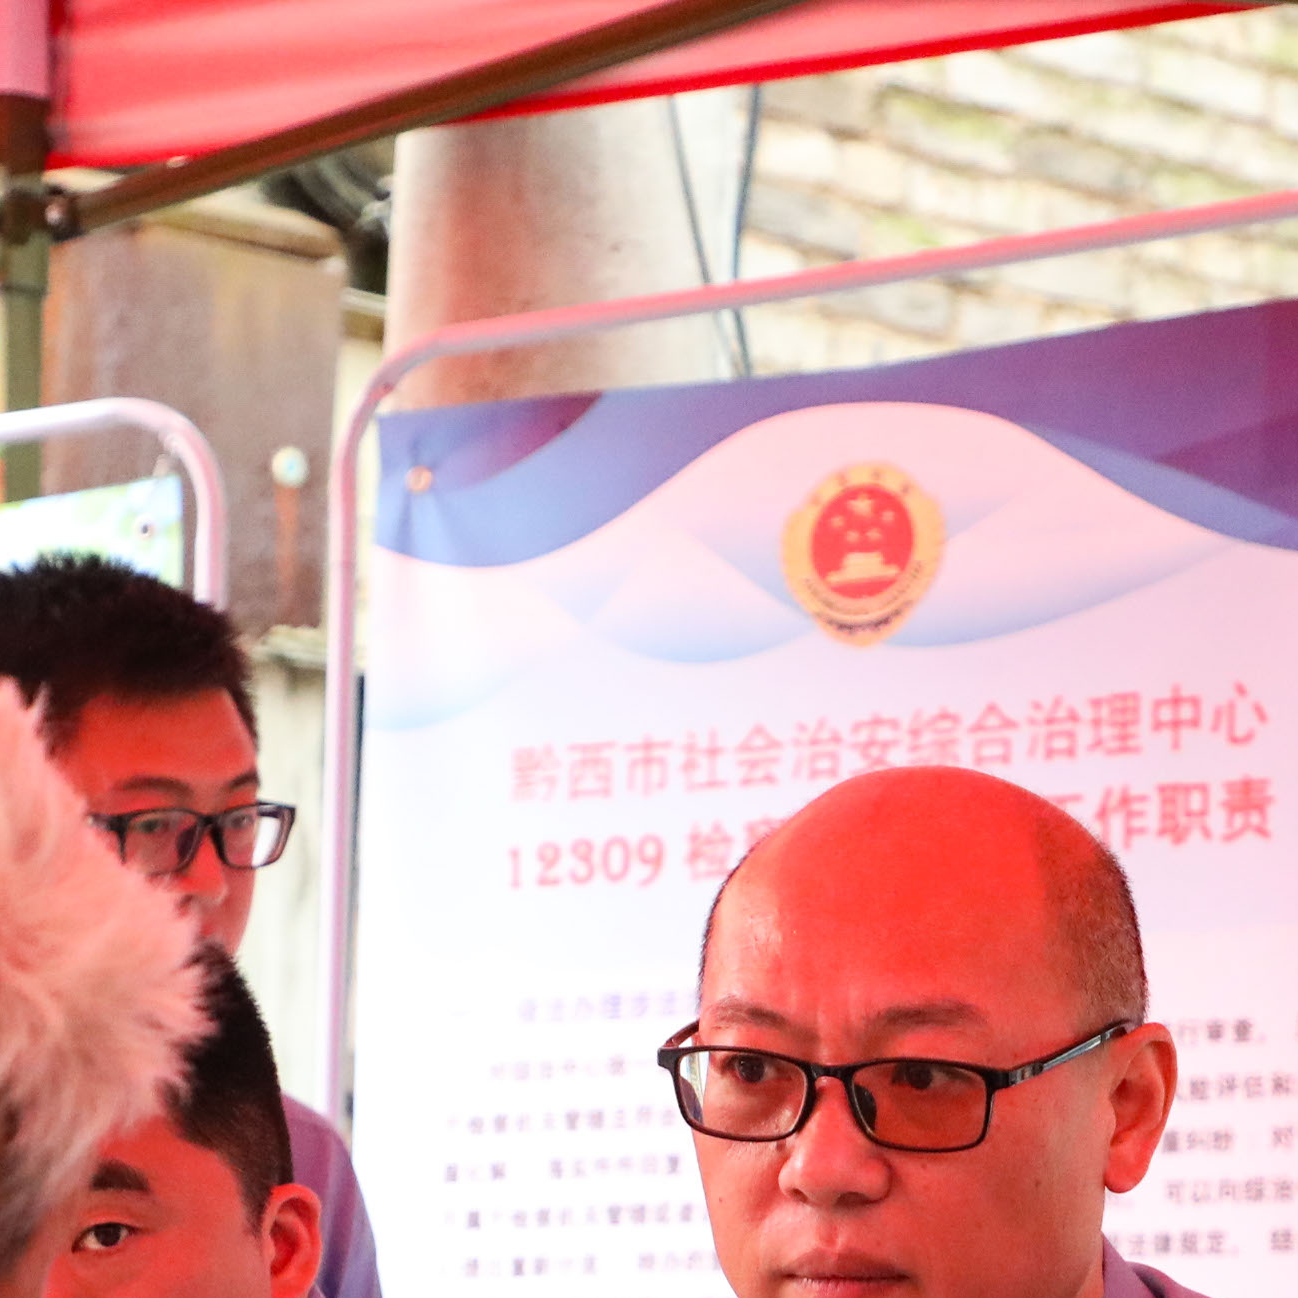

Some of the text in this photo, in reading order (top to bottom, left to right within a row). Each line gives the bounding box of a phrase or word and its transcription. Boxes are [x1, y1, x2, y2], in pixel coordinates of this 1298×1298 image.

[511, 680, 1269, 802] 黔西市社会治安综合治理中心
[508, 834, 666, 889] 12309
